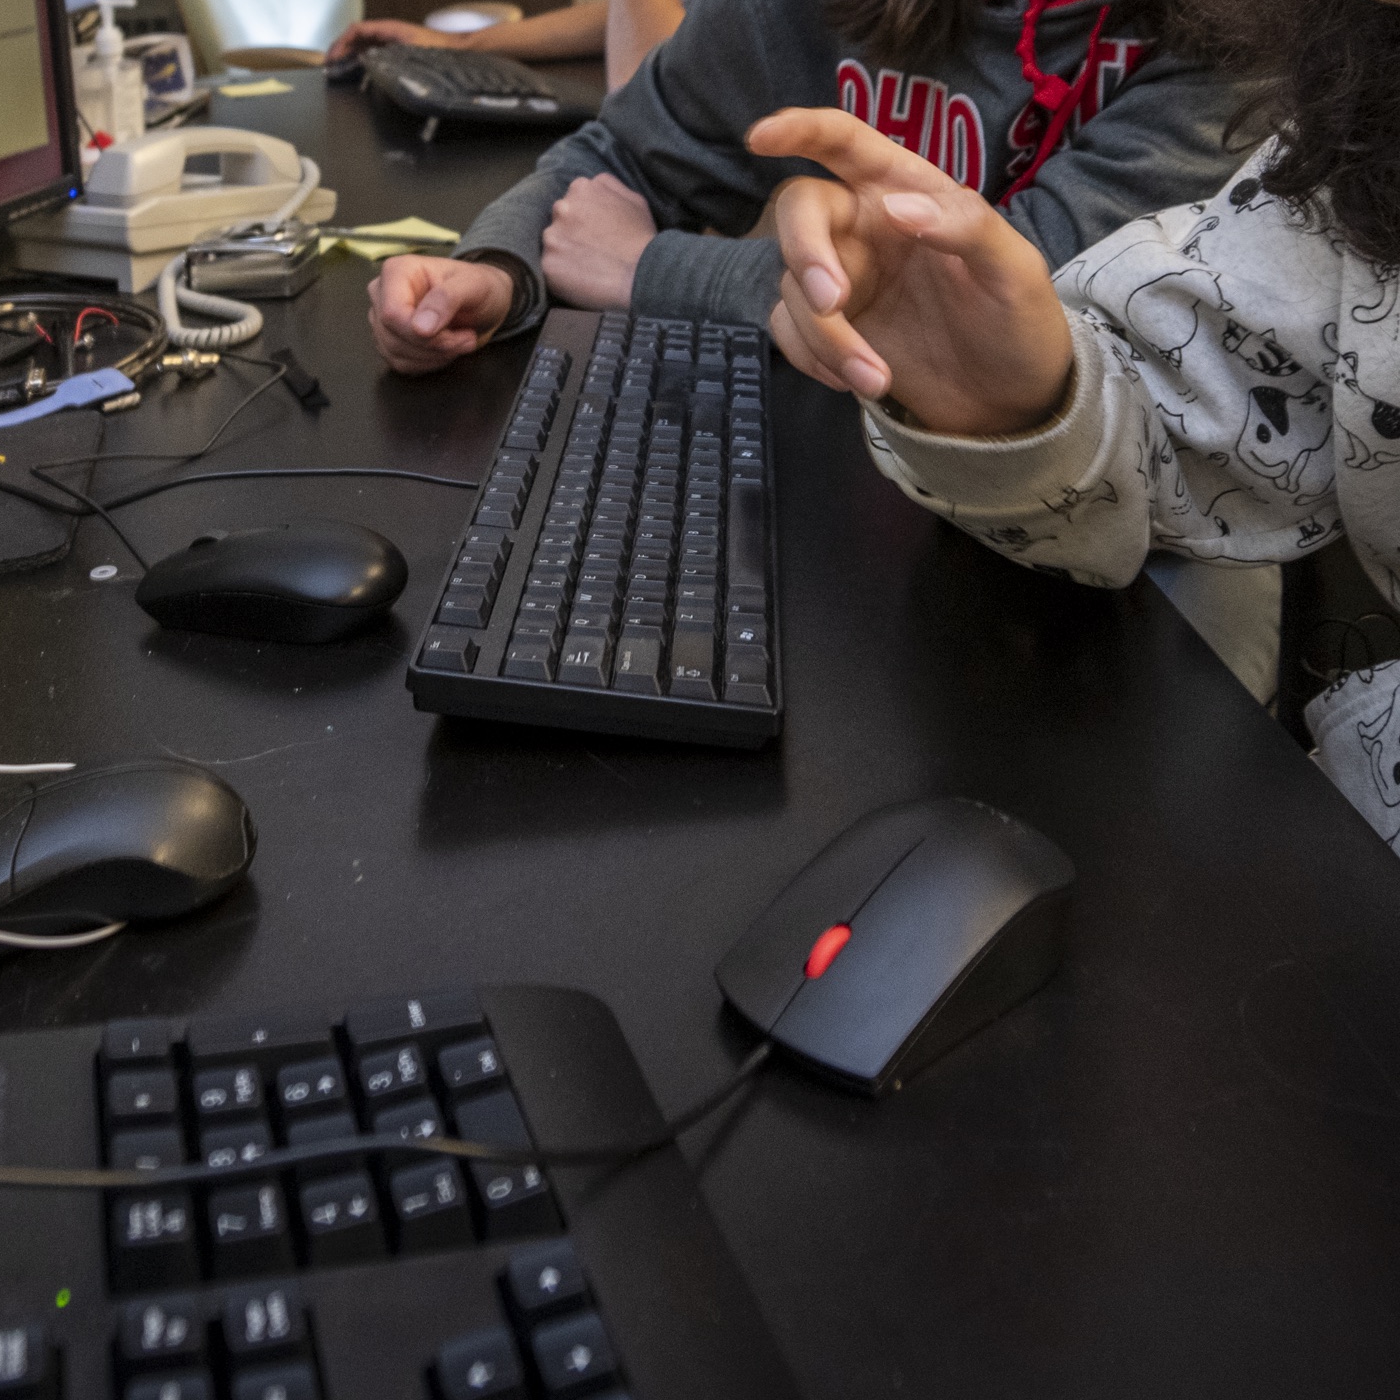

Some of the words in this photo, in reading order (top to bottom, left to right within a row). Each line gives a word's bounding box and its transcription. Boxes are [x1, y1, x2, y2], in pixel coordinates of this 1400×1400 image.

[369, 1072, 392, 1090] 3
[201, 1089, 226, 1106] 9
[285, 1084, 309, 1100] 6
[487, 1178, 512, 1199] 0
[311, 1203, 338, 1225] 4
[218, 1214, 244, 1235] 7
